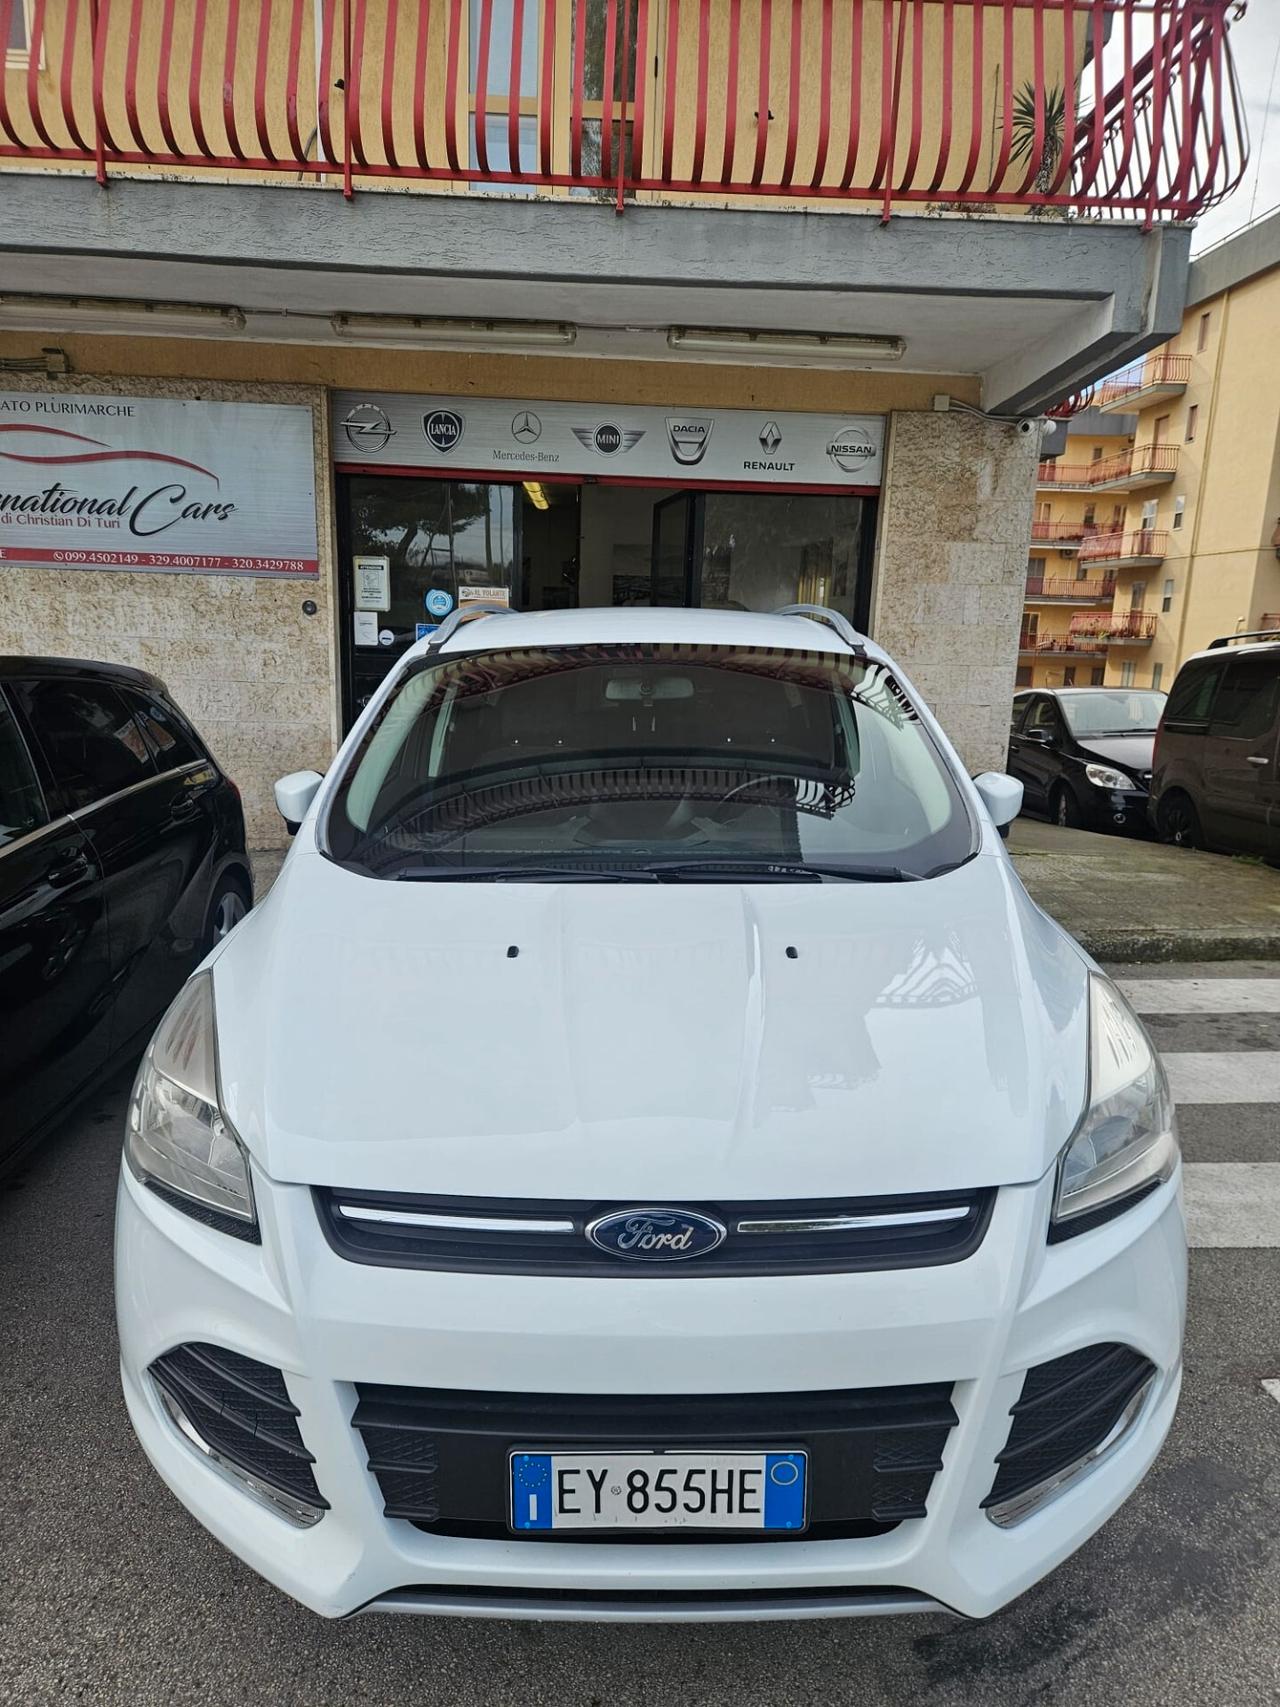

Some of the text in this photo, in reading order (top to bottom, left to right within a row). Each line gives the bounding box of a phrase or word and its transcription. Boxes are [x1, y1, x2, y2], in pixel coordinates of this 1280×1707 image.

[0, 400, 137, 417] ATO PLURIMARCHE
[431, 423, 457, 436] LANCIA
[673, 425, 705, 433] DACIA
[597, 434, 620, 445] MINI
[492, 449, 560, 463] Mercedes-Benz
[831, 444, 872, 454] NISSAN
[743, 461, 796, 471] RENAULT
[0, 483, 238, 537] national Cars
[2, 512, 120, 529] di Christian Di Turi
[65, 551, 138, 564] 099.4502149
[149, 554, 221, 568] 329.4007177
[232, 558, 304, 571] 320.3429788
[617, 1216, 695, 1250] Ford
[557, 1469, 763, 1515] EY 855HE
